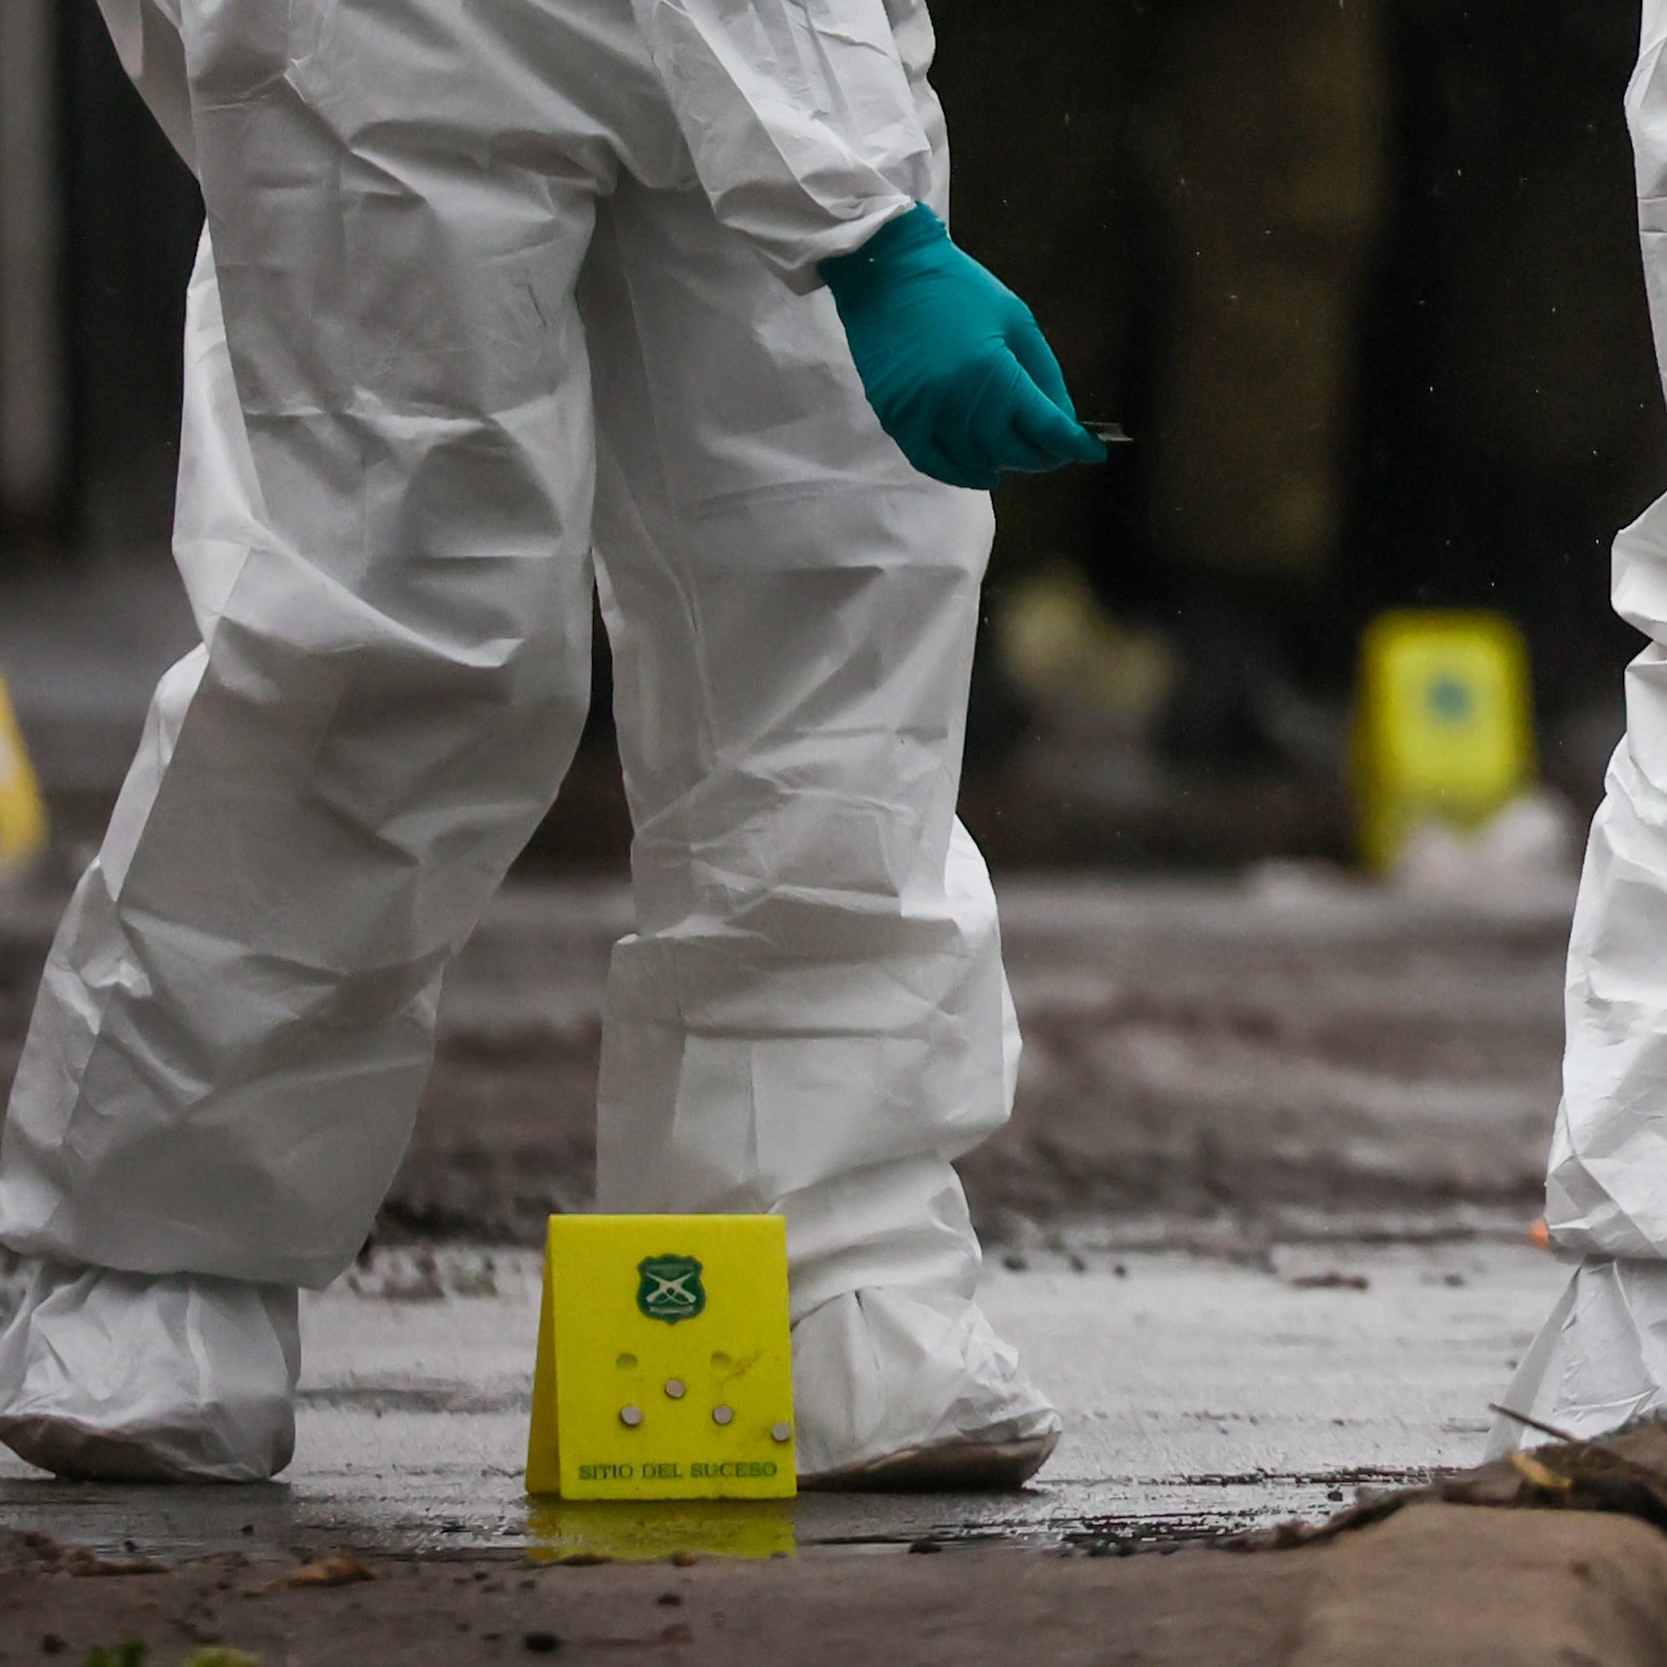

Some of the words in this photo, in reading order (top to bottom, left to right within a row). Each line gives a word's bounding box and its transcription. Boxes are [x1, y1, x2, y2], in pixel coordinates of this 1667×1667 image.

[578, 1464, 634, 1480] SITIO
[641, 1463, 683, 1479] DEL
[690, 1461, 778, 1479] SUCESO
